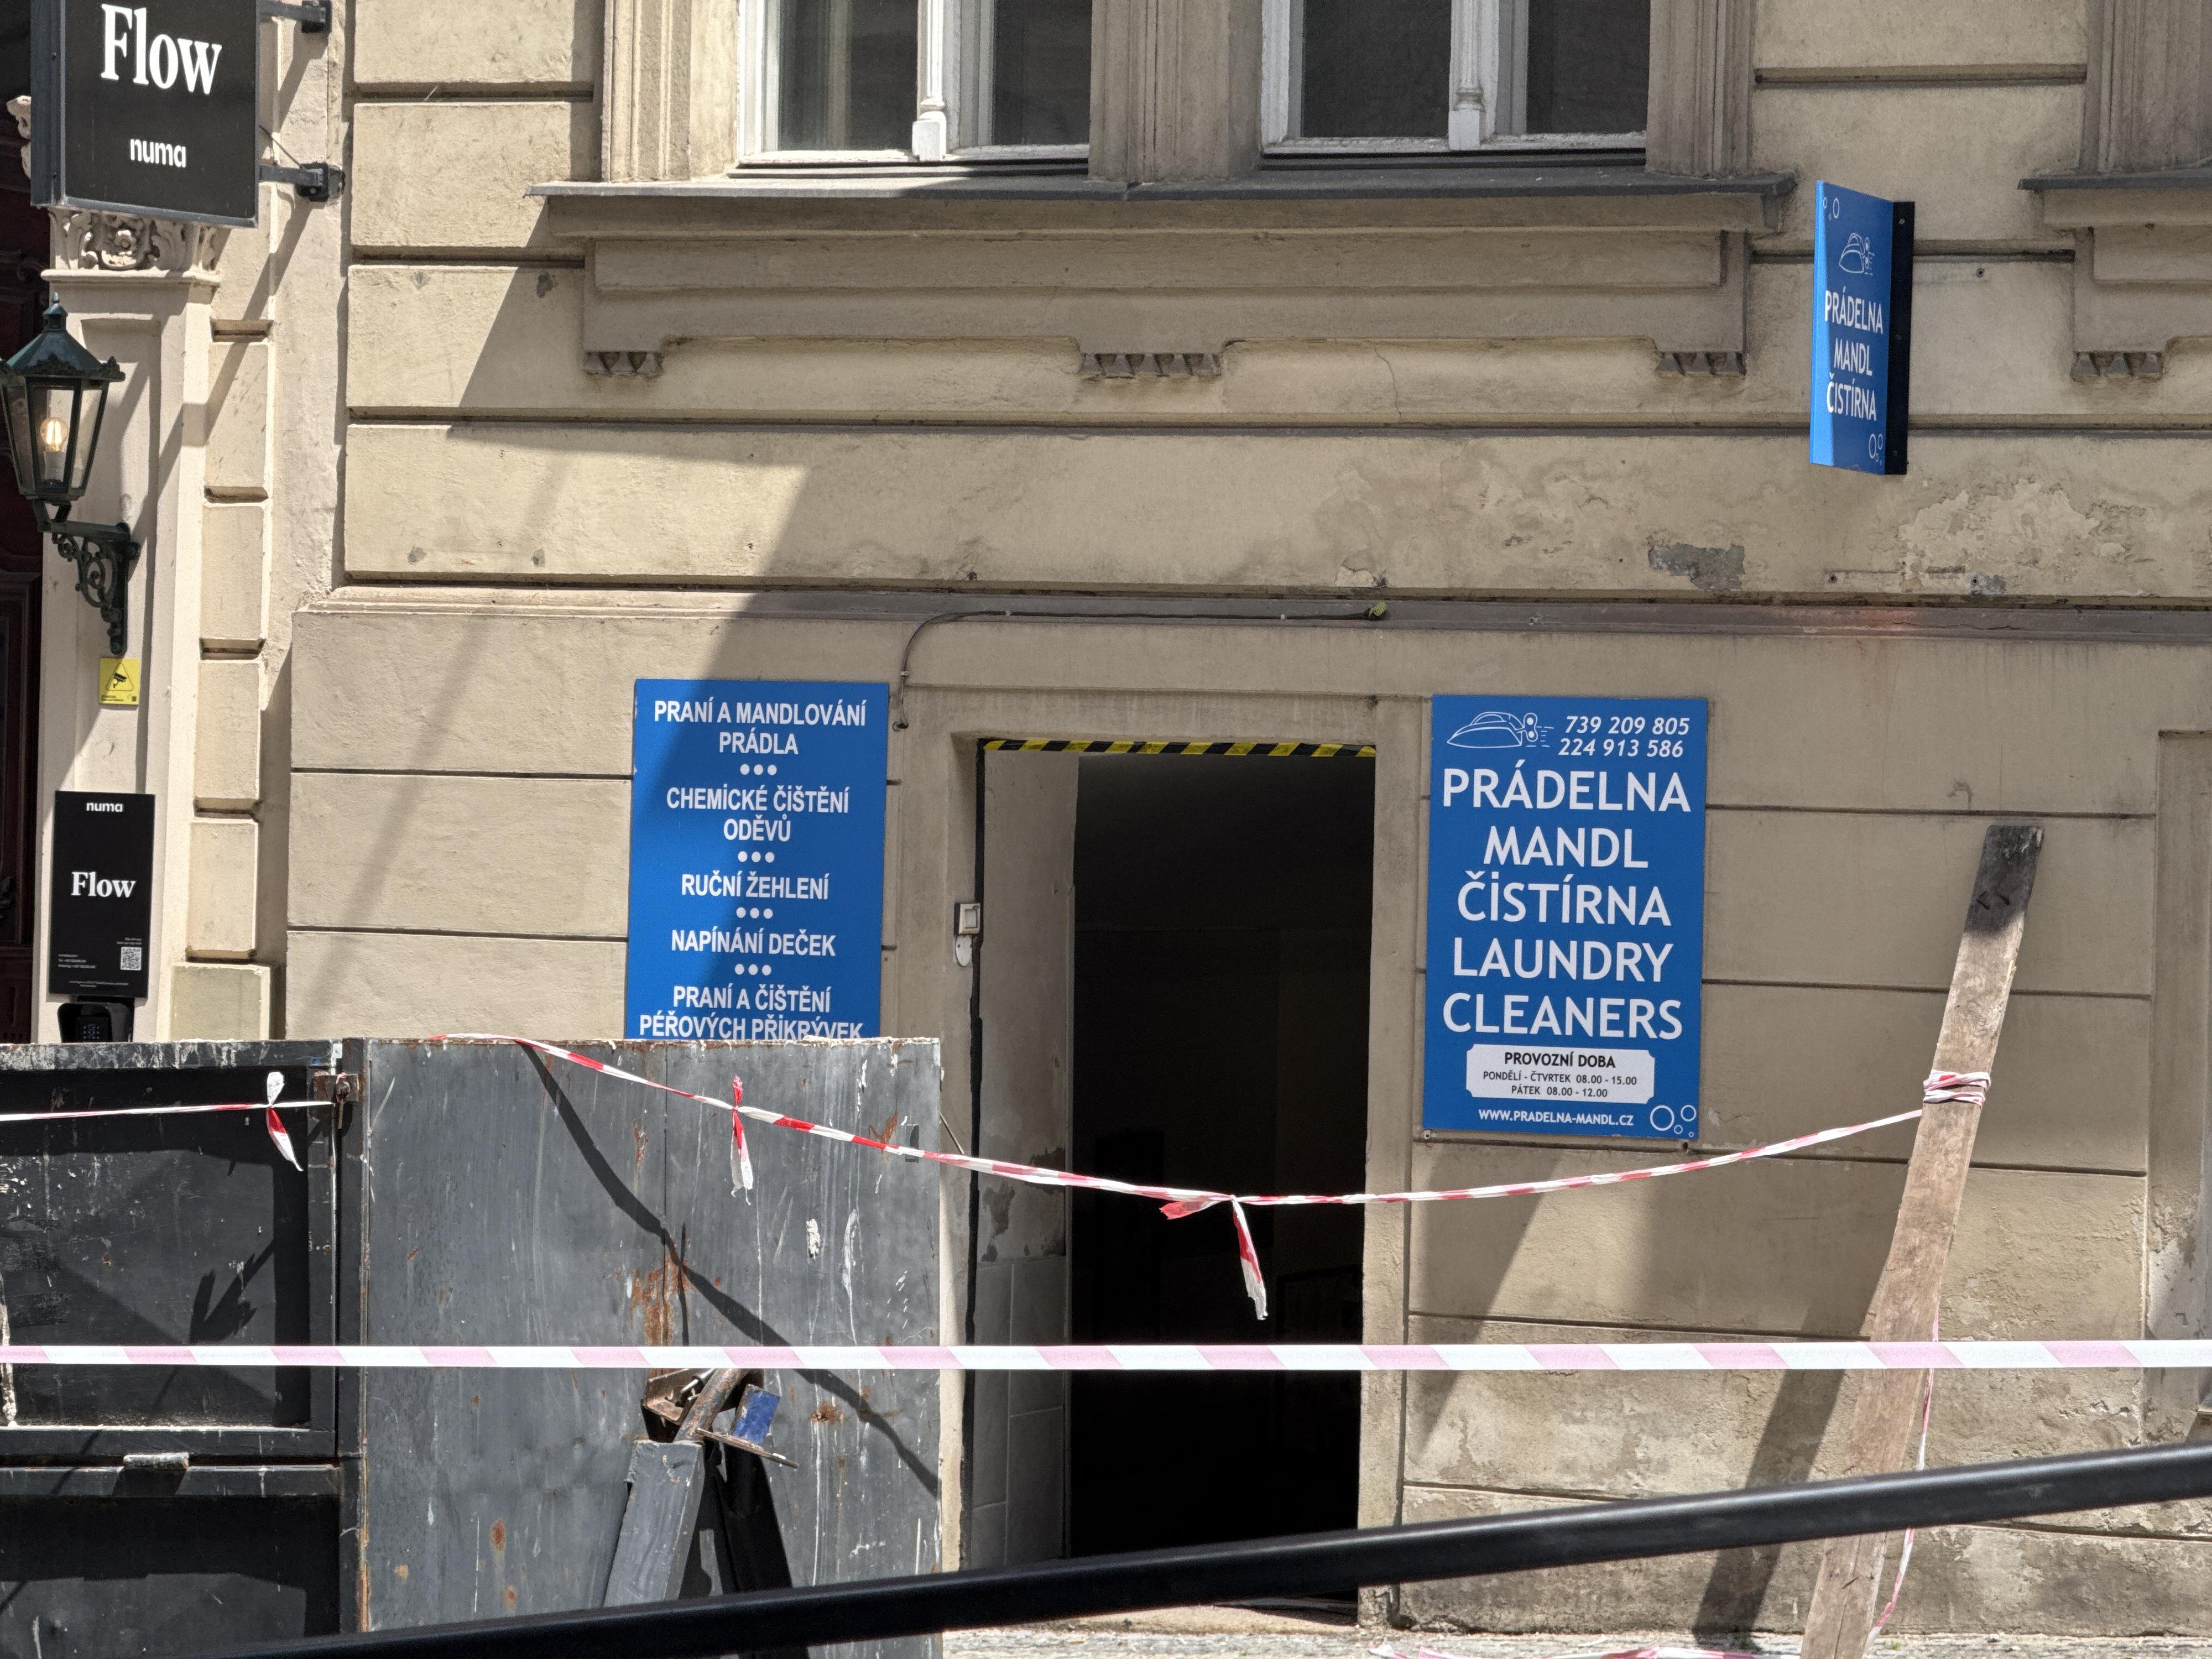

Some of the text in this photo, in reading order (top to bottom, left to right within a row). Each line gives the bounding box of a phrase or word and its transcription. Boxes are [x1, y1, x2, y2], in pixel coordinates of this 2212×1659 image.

[101, 4, 222, 95] Flow
[130, 138, 186, 168] numa
[1825, 286, 1883, 334] PRÁDELNA
[1834, 338, 1872, 377] MANDL
[1827, 373, 1876, 421] ČISTÍRNA
[655, 697, 867, 726] PRANÍ A MANDLOVÁNÍ
[1565, 716, 1689, 735] 739 209 805
[719, 728, 799, 755] PRÁDLA
[1558, 738, 1683, 758] 224 913 586
[1443, 759, 1691, 812] PRÁDELNA
[86, 801, 123, 813] numa
[724, 813, 791, 842] ODĚVŮ
[1483, 826, 1648, 868] MANDL
[71, 871, 136, 898] Flow
[681, 870, 830, 900] RUČNÍ ŽEHLENÍ
[671, 926, 836, 957] NAPÍNÁNÍ DEČEK
[1454, 937, 1673, 982] LAUNDRY
[674, 983, 733, 1009] PRANÍ
[736, 989, 750, 1009] A
[640, 1010, 745, 1039] PÉŘOVÝCH
[1443, 993, 1682, 1040] CLEANERS
[1504, 1051, 1615, 1068] PROVOZNÍ DOBA
[1483, 1070, 1521, 1081] PONDĚLÍ
[1530, 1071, 1571, 1083] ČTVRTEK
[1576, 1075, 1602, 1084] 08.00
[1611, 1076, 1637, 1086] 15.00
[1511, 1084, 1541, 1095] PÁTEK
[1547, 1087, 1573, 1097] 08.00
[1582, 1088, 1608, 1098] 12.00
[1478, 1109, 1634, 1126] WWW.PRADELNA-MANDL.CZ
